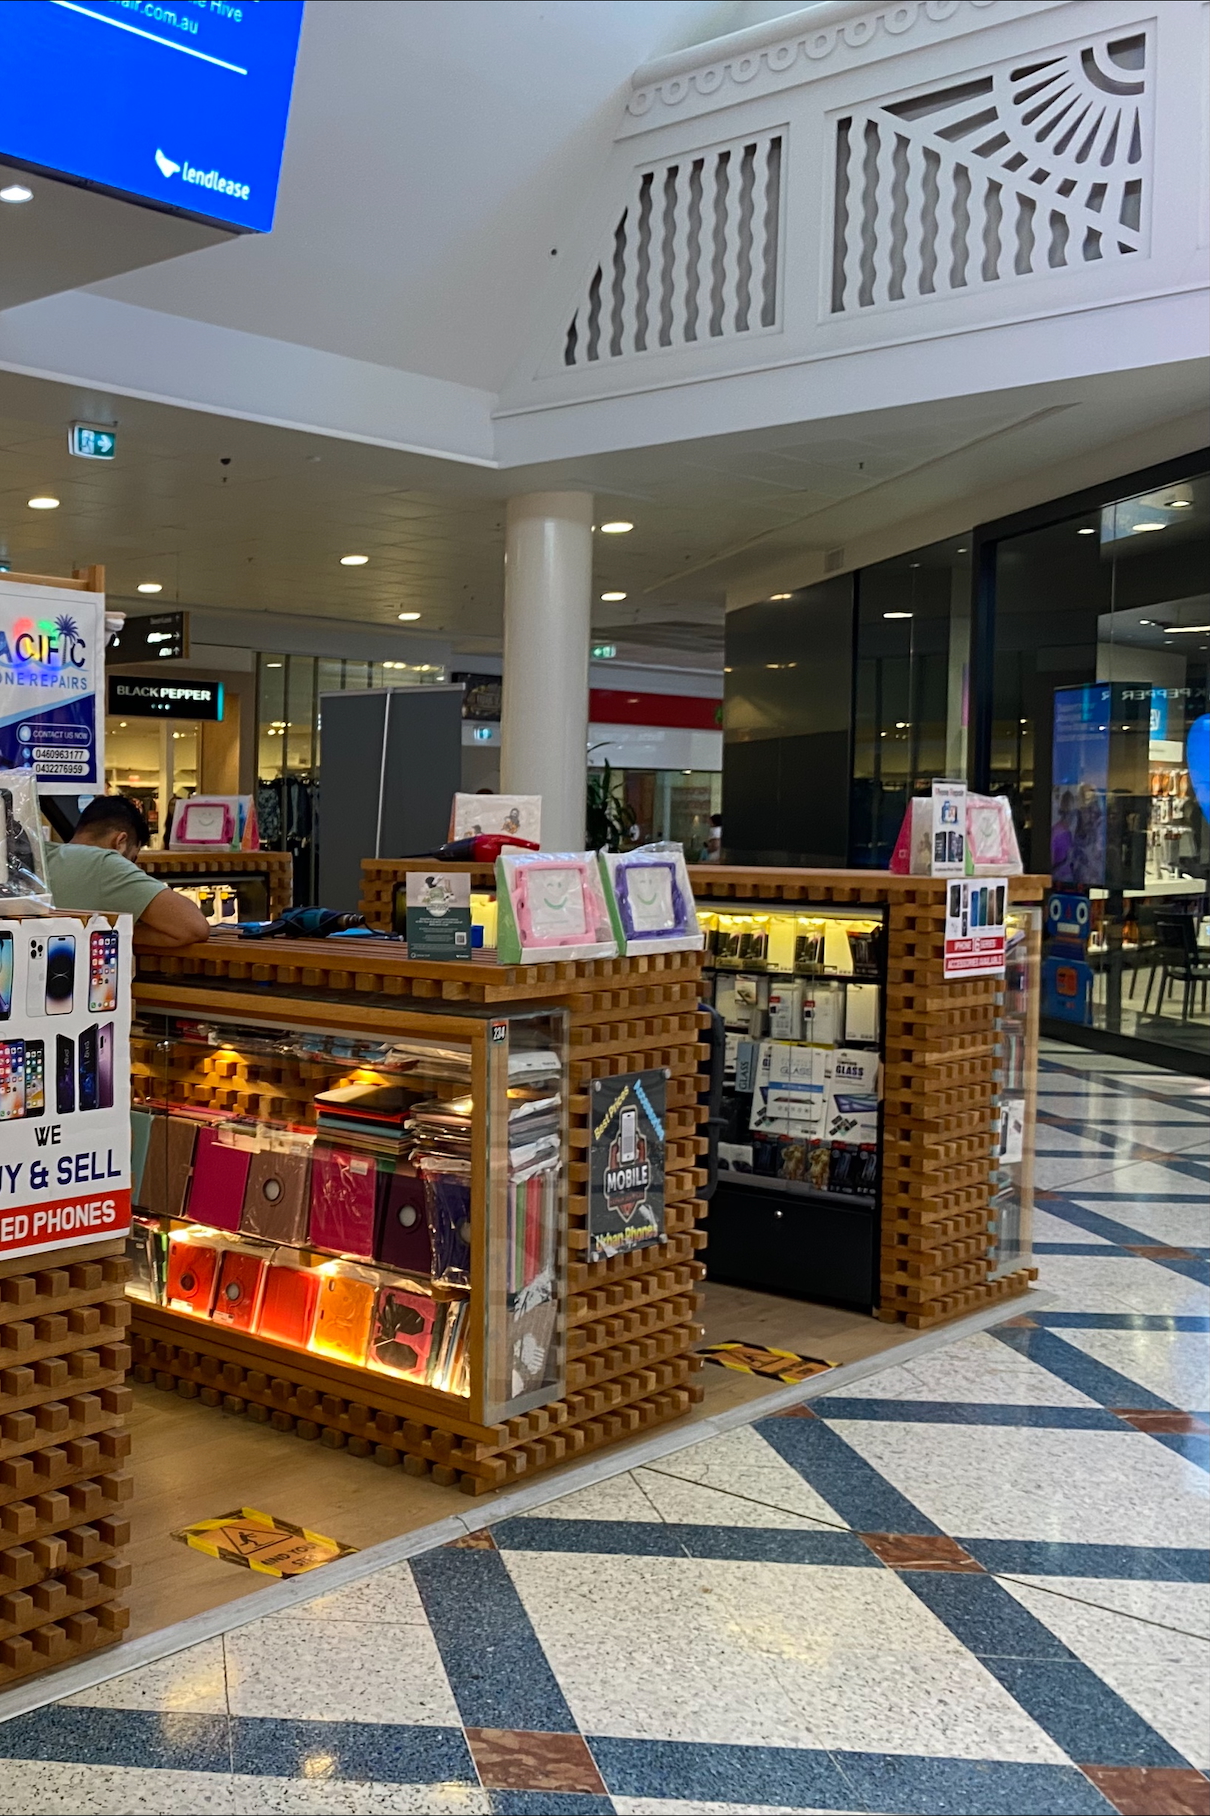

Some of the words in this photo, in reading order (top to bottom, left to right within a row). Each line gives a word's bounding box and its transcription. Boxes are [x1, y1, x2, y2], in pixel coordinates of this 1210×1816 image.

[112, 0, 200, 34] air.com.au
[182, 161, 251, 200] lendlease
[30, 673, 88, 690] REPAIRS
[116, 685, 159, 698] BLACK
[160, 687, 212, 701] PEPPER
[33, 730, 63, 738] CONTACT
[64, 731, 74, 739] US
[36, 749, 84, 759] 0460963177
[36, 764, 83, 774] 0432276959
[493, 1026, 505, 1040] 234
[835, 1065, 864, 1077] GLASS
[594, 1113, 611, 1140] Best
[608, 1085, 629, 1118] Prices
[34, 1124, 61, 1147] WE
[29, 1160, 49, 1190] &
[57, 1149, 121, 1186] SELL
[607, 1165, 648, 1193] MOBILE
[33, 1199, 116, 1236] PHONES
